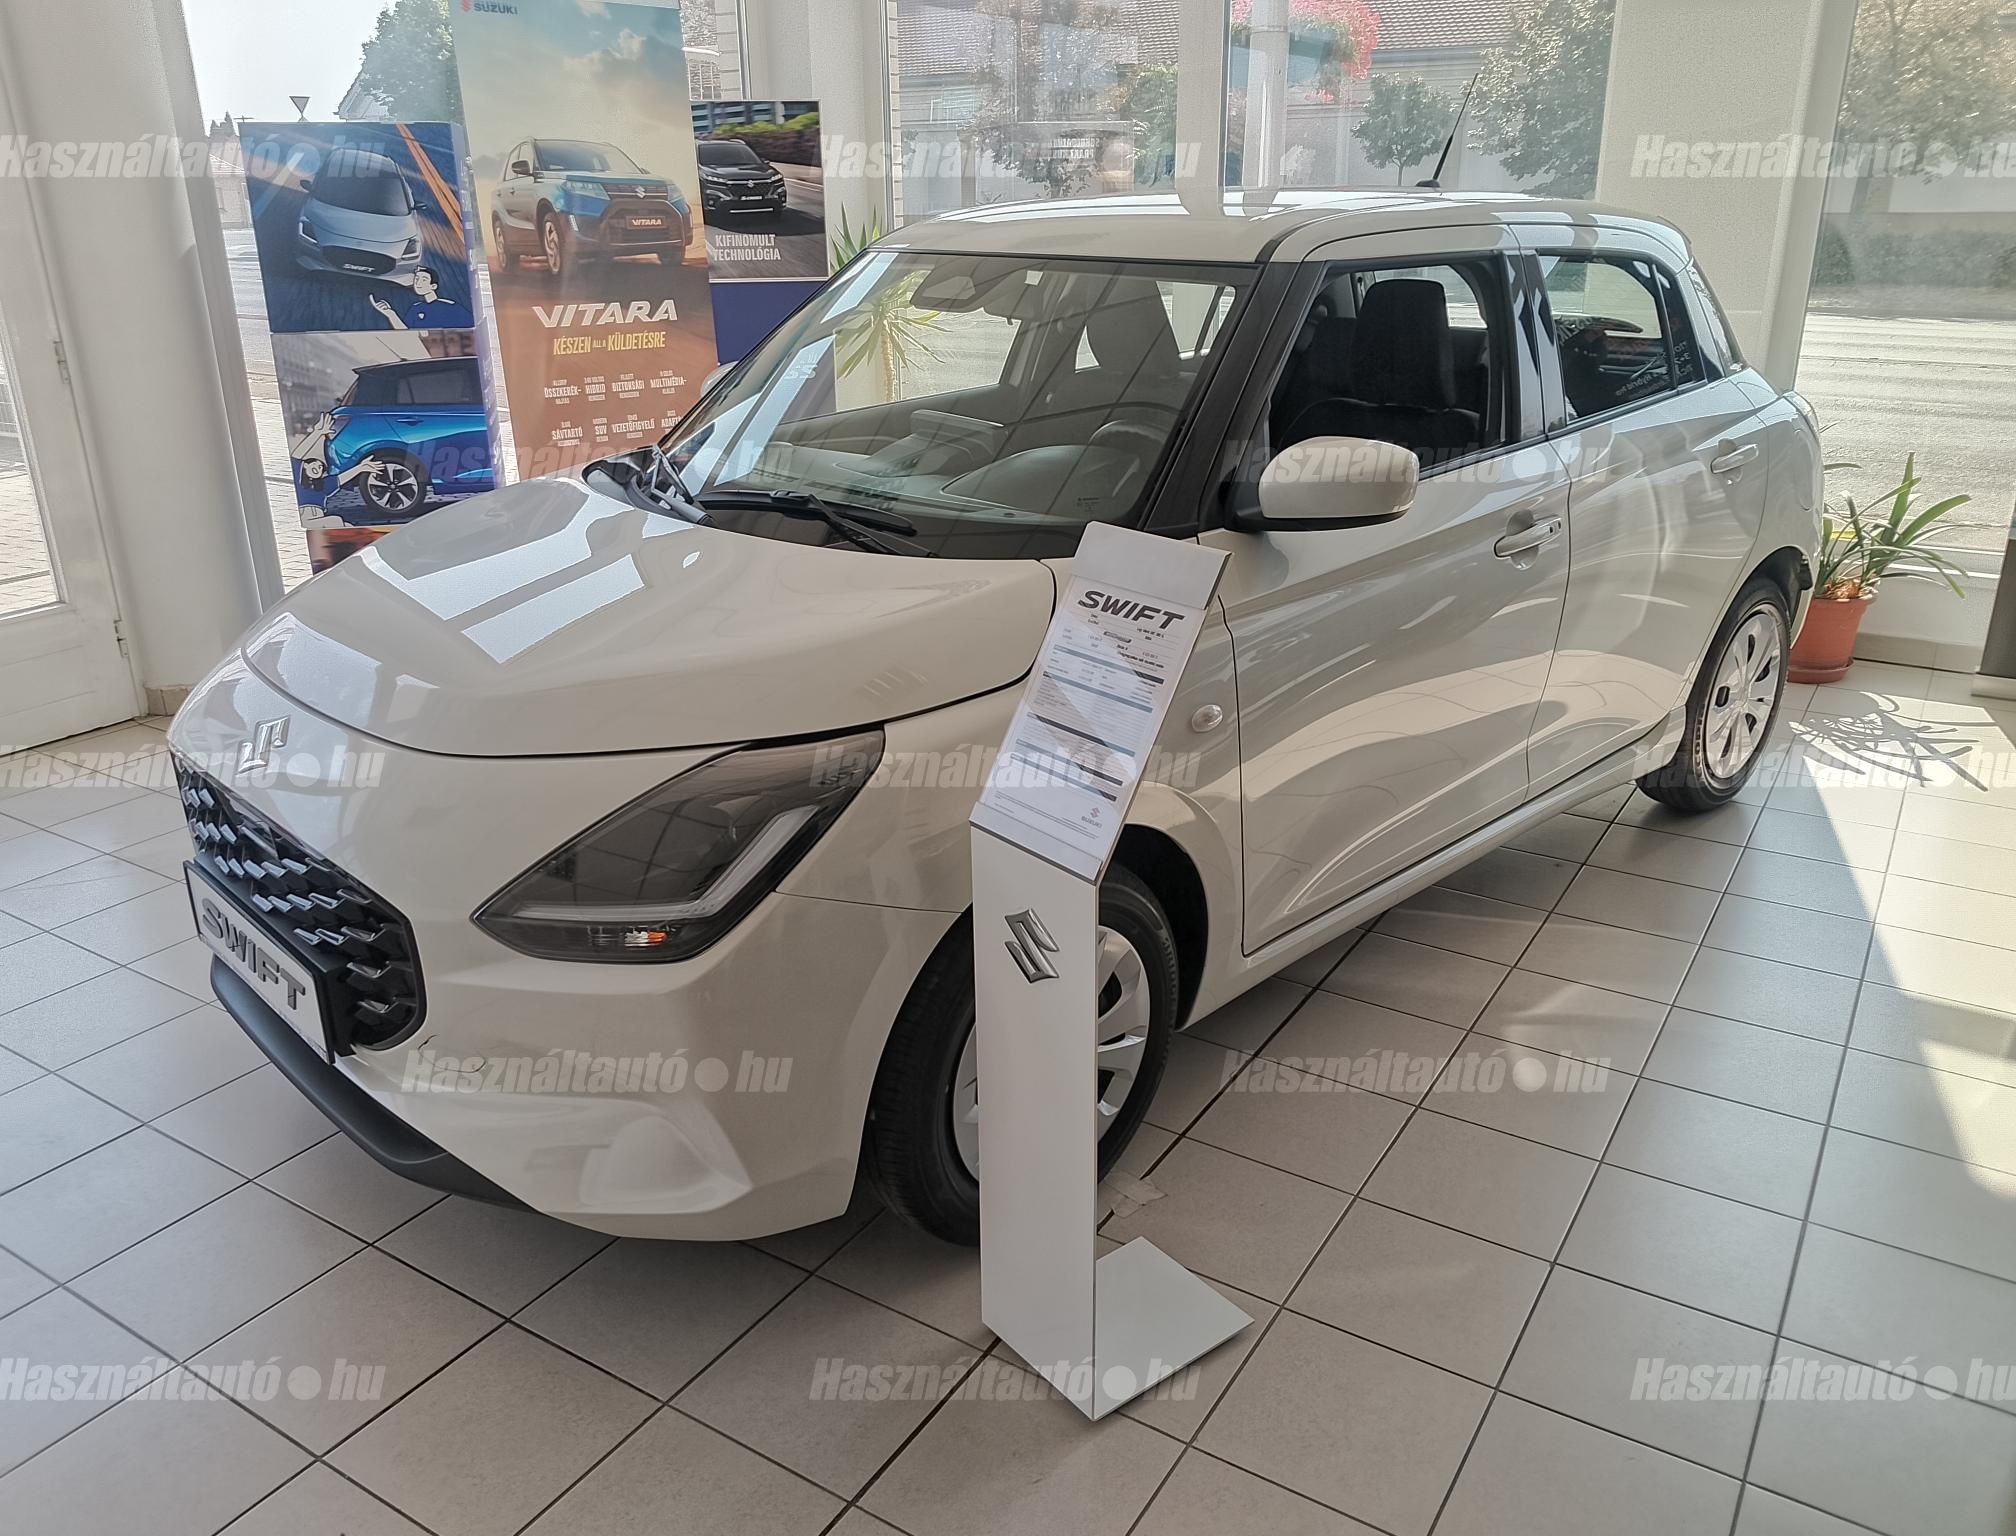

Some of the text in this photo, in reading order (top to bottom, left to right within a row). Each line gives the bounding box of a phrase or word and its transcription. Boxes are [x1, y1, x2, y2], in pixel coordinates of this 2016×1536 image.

[473, 2, 518, 15] SUZUKI
[715, 234, 776, 247] KIFINOMULT
[713, 246, 782, 261] TECHNOLÓGIA
[532, 300, 678, 328] VITARA
[553, 335, 592, 355] KÉSZEN
[608, 331, 667, 351] KÜLDETÉSRE
[1078, 590, 1185, 629] SWIFT
[202, 898, 306, 1010] SWIFT
